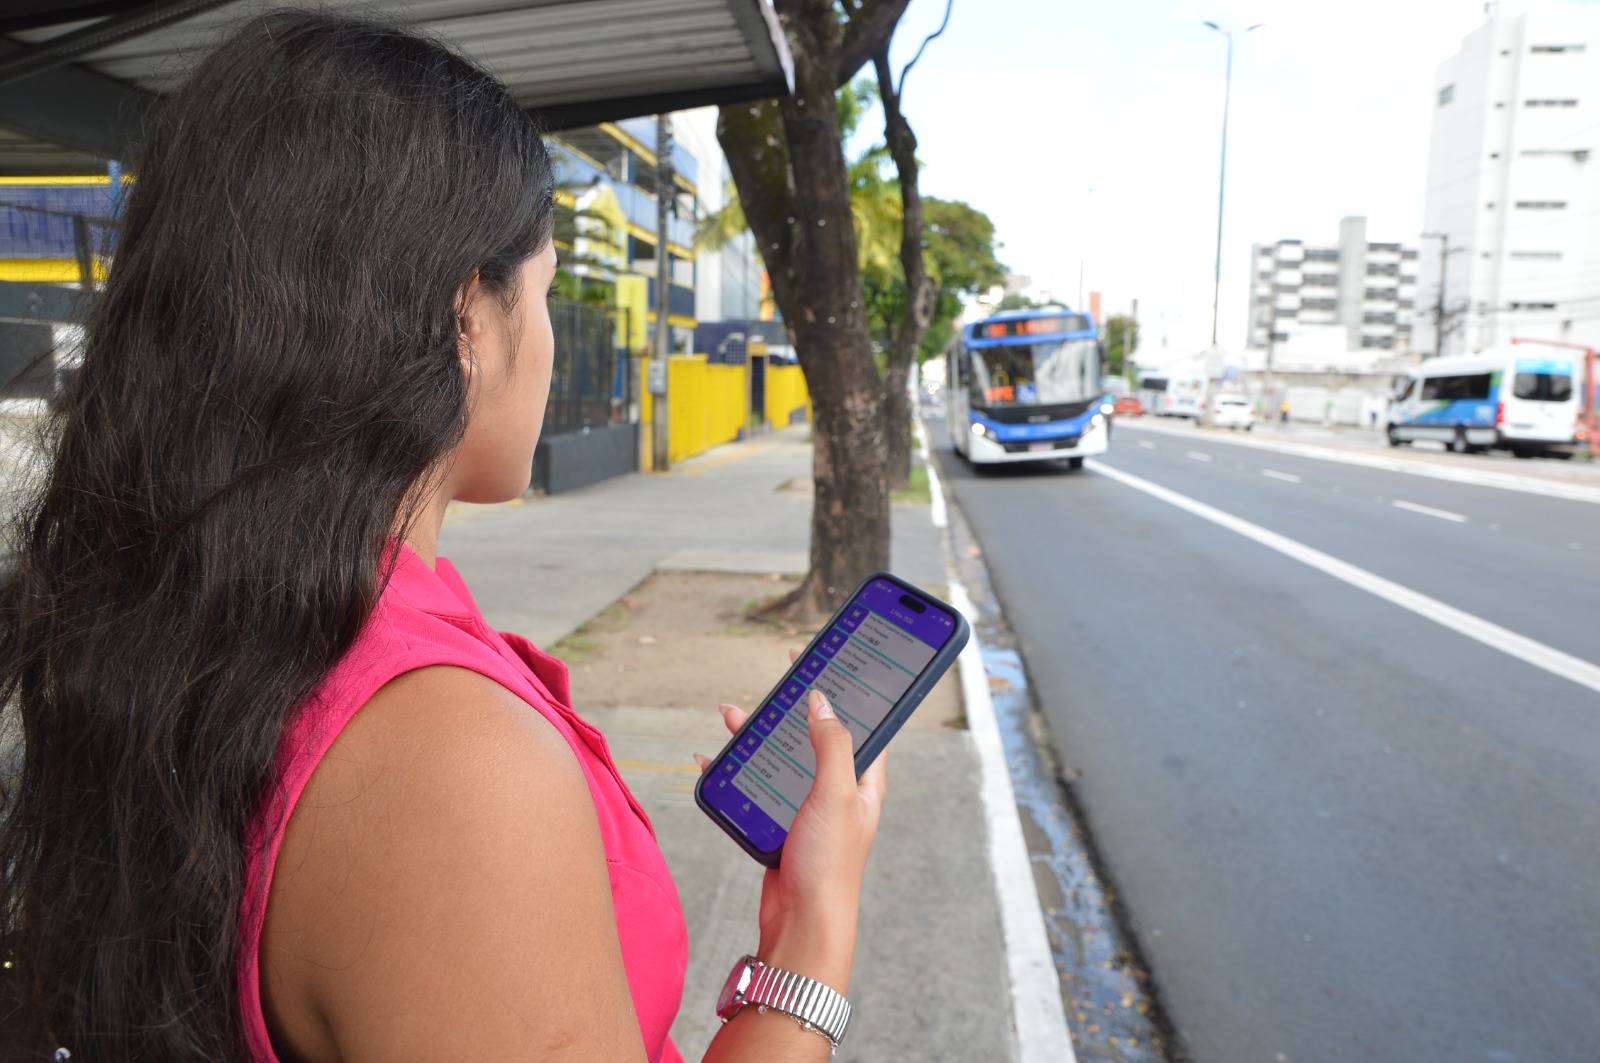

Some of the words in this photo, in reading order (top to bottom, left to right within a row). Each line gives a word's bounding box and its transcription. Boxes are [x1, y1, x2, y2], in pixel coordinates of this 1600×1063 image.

[889, 608, 904, 619] Linha
[846, 620, 856, 628] min
[826, 645, 835, 653] min
[805, 671, 815, 679] min
[783, 696, 793, 705] min
[762, 722, 772, 731] min
[741, 748, 750, 757] min
